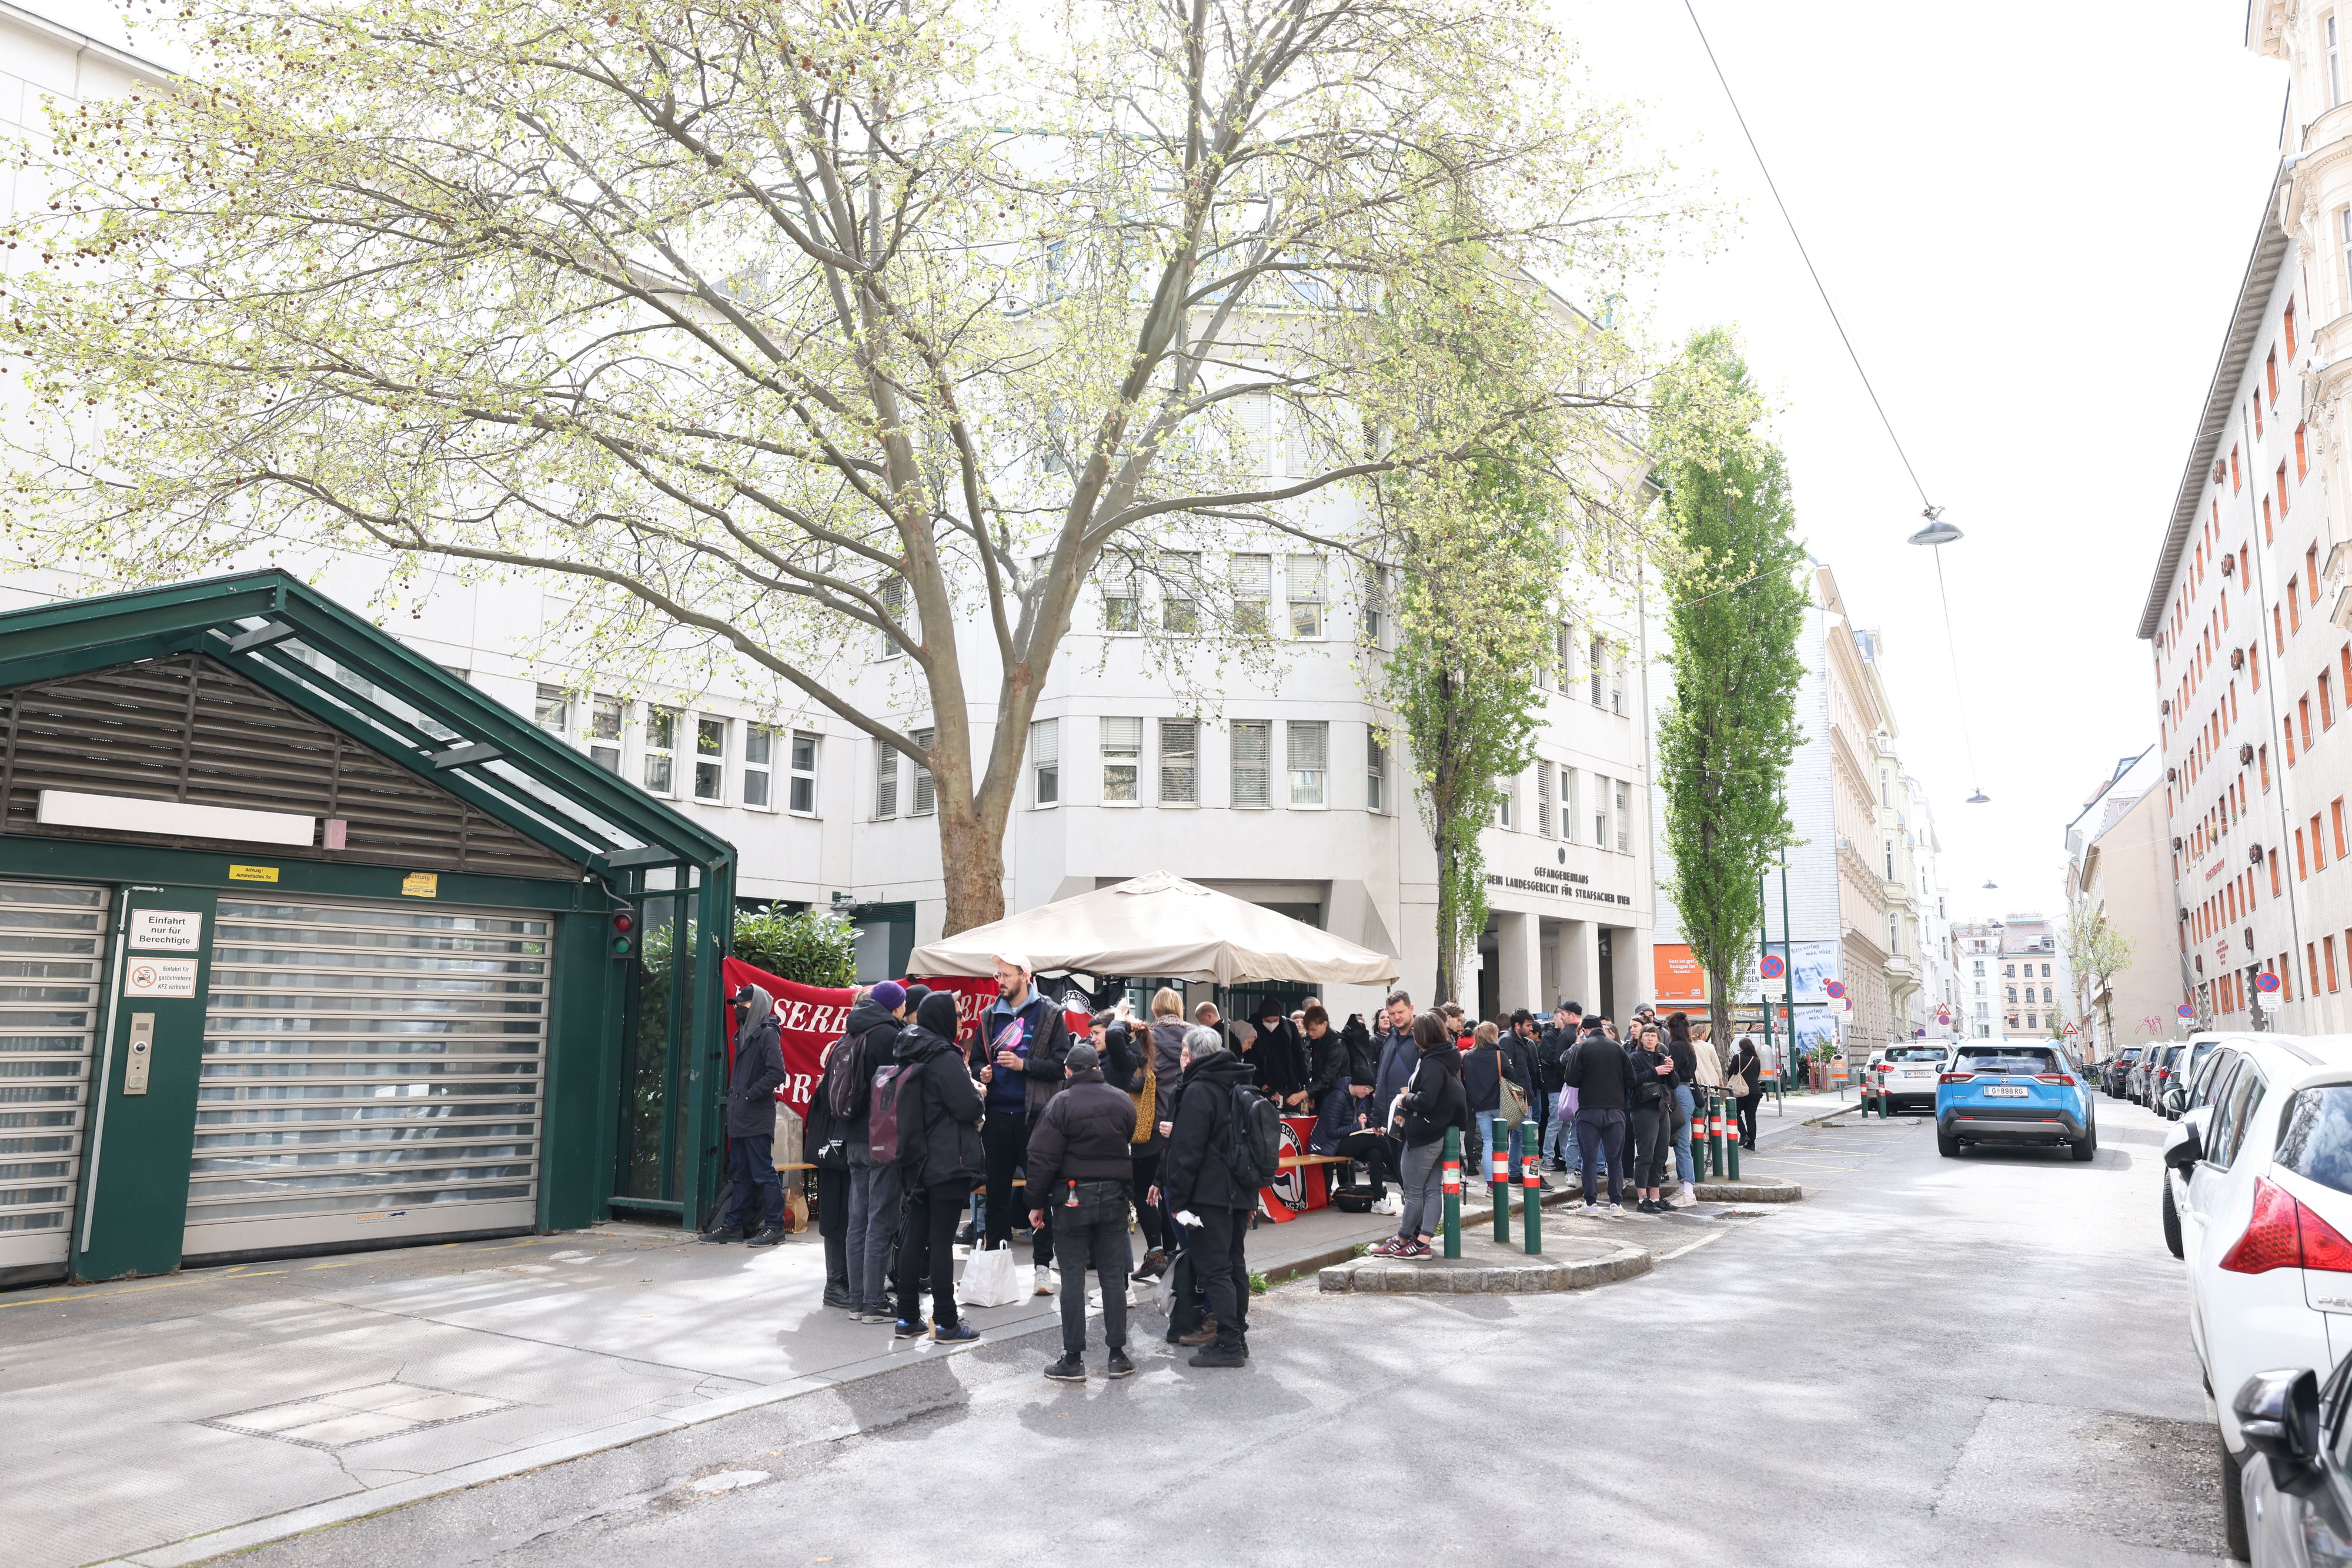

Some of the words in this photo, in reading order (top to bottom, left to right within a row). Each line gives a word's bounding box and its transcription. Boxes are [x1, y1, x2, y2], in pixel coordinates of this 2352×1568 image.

[1534, 867, 1589, 884] GEFANGENENHAUS
[1487, 874, 1503, 885] BEIM
[1505, 877, 1558, 894] LANDESGERICHT
[1561, 884, 1572, 897] FÜR
[1575, 888, 1615, 903] STRAFSACHEN
[1617, 895, 1631, 905] WIEN
[148, 916, 186, 925] Einfahrt
[139, 935, 191, 945] Berechtigte
